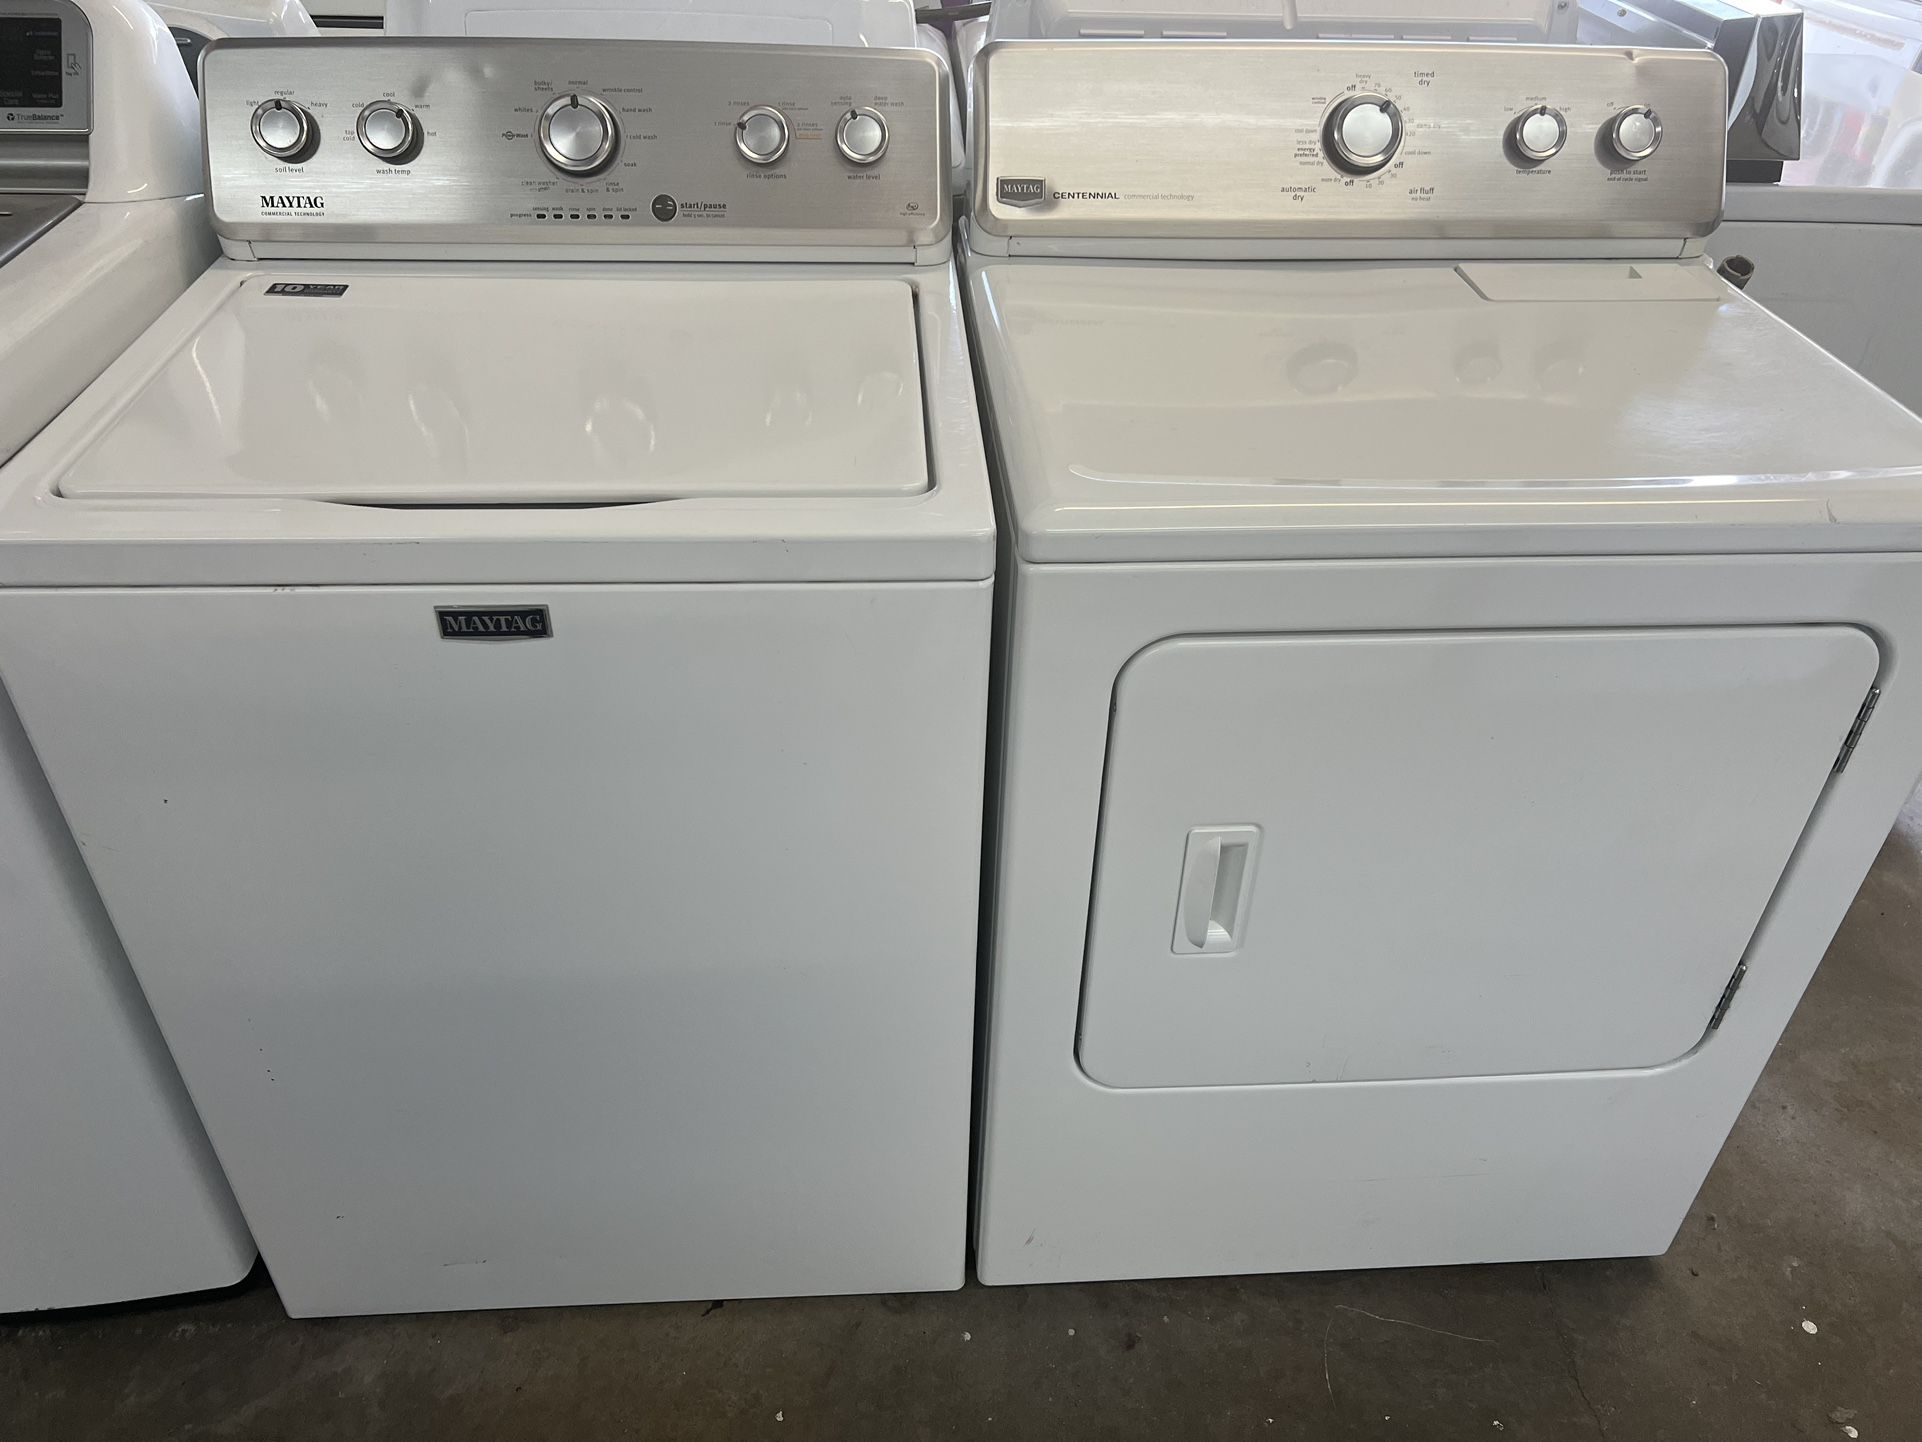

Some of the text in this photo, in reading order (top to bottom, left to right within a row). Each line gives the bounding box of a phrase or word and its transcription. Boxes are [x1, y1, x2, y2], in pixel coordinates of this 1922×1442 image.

[1003, 184, 1040, 193] MAYTAG
[260, 196, 324, 208] MAYTAG
[1161, 193, 1194, 201] technology
[681, 201, 727, 211] start/pause
[444, 615, 542, 631] MAYTAG
